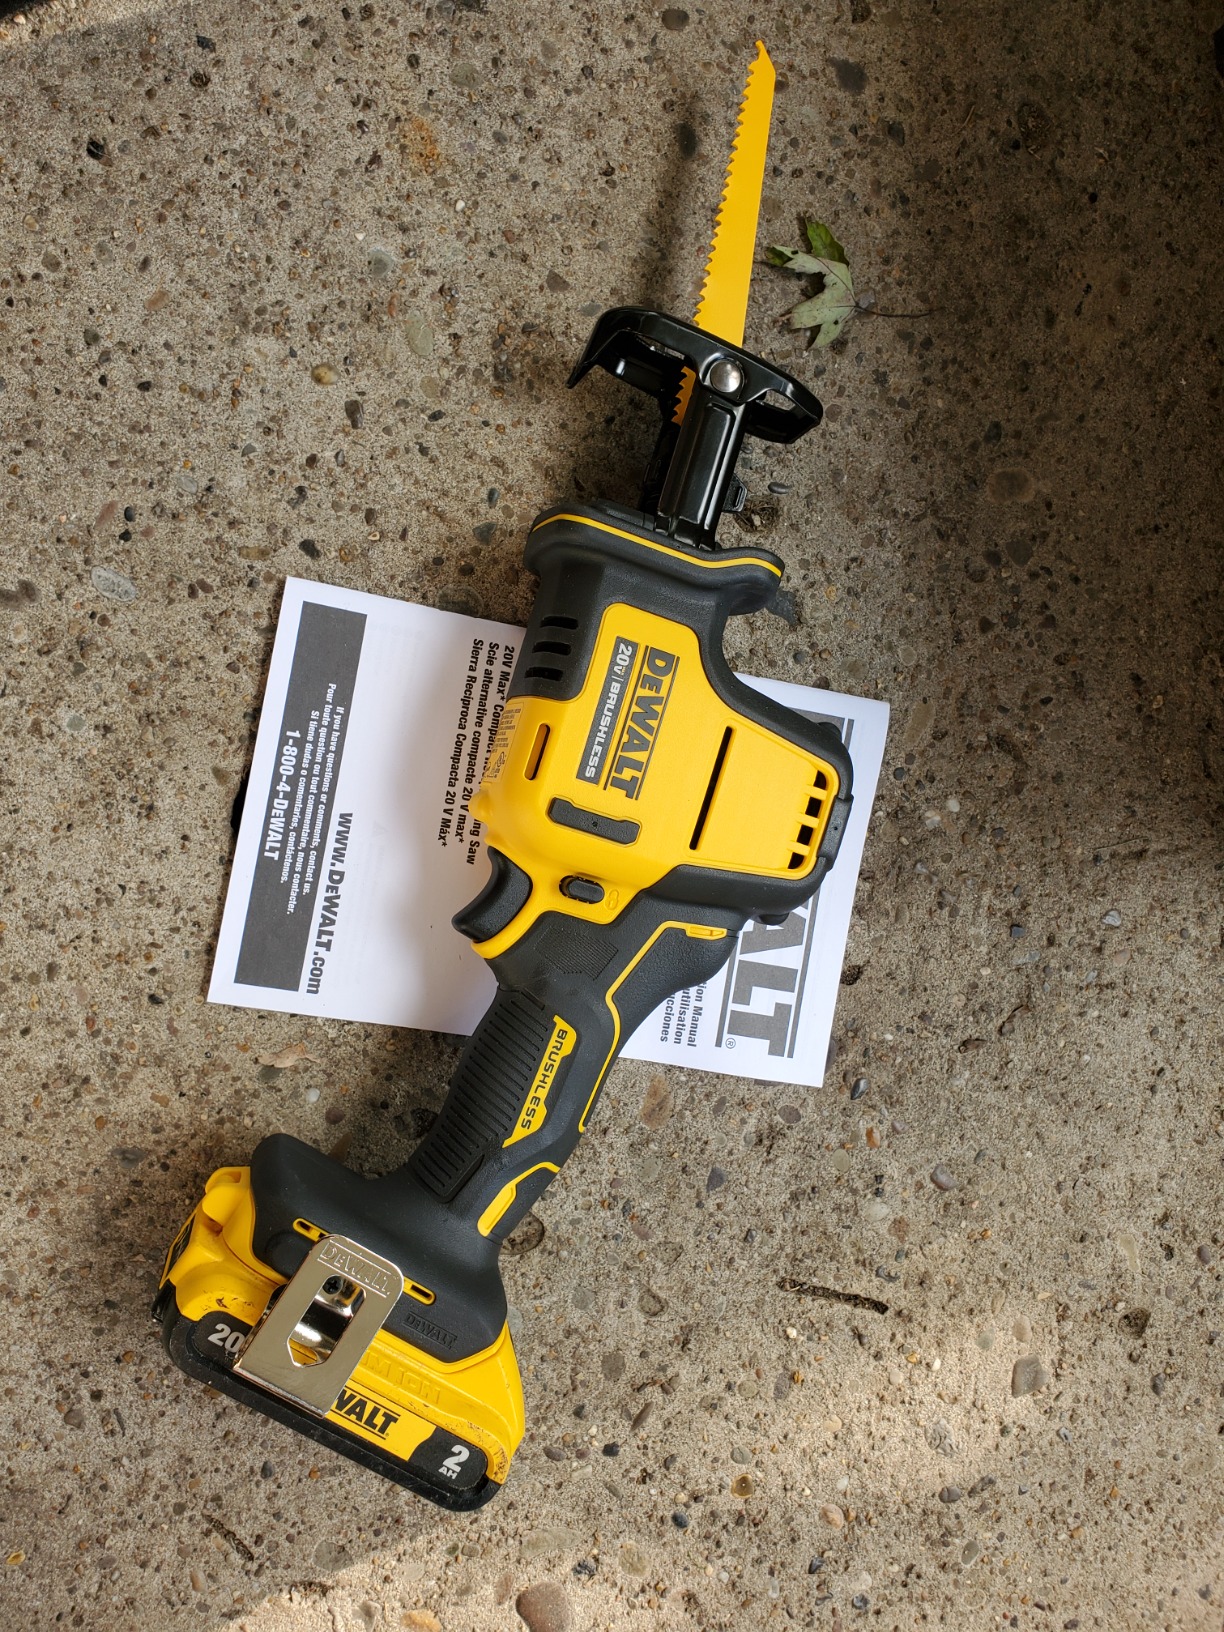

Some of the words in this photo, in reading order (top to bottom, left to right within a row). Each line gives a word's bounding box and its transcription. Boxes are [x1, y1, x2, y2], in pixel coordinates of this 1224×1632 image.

[468, 638, 484, 672] Sierra
[486, 642, 500, 666] Scie
[502, 645, 515, 668] 20V
[326, 683, 336, 703] Pour
[458, 675, 477, 730] Recíproca
[474, 668, 493, 728] alternative
[310, 710, 320, 719] Si
[322, 704, 333, 726] toute
[333, 714, 341, 730] you
[336, 706, 344, 714] If
[306, 721, 318, 741] tiene
[329, 731, 340, 751] have
[585, 681, 621, 778] BRUSHLESS
[302, 743, 313, 768] dudas
[315, 727, 327, 762] question
[465, 730, 481, 784] compacte
[313, 764, 320, 775] ou
[322, 752, 335, 792] questions
[448, 733, 467, 787] Compacta
[309, 776, 320, 793] tout
[461, 786, 473, 801] 20
[289, 777, 306, 829] comentarios,
[320, 794, 327, 803] or
[444, 790, 456, 805] 20
[297, 794, 315, 850] commentaire,
[443, 808, 454, 816] V
[310, 804, 325, 848] comments,
[280, 831, 296, 883] contáctenos.
[295, 852, 304, 872] nous
[466, 840, 480, 865] Saw
[305, 850, 317, 881] contact
[287, 873, 300, 914] contacter.
[302, 883, 310, 895] us.
[727, 900, 809, 1057] ALT
[687, 1006, 703, 1047] Manual
[521, 1028, 568, 1129] BRUSHLESS
[442, 1444, 470, 1472] 2
